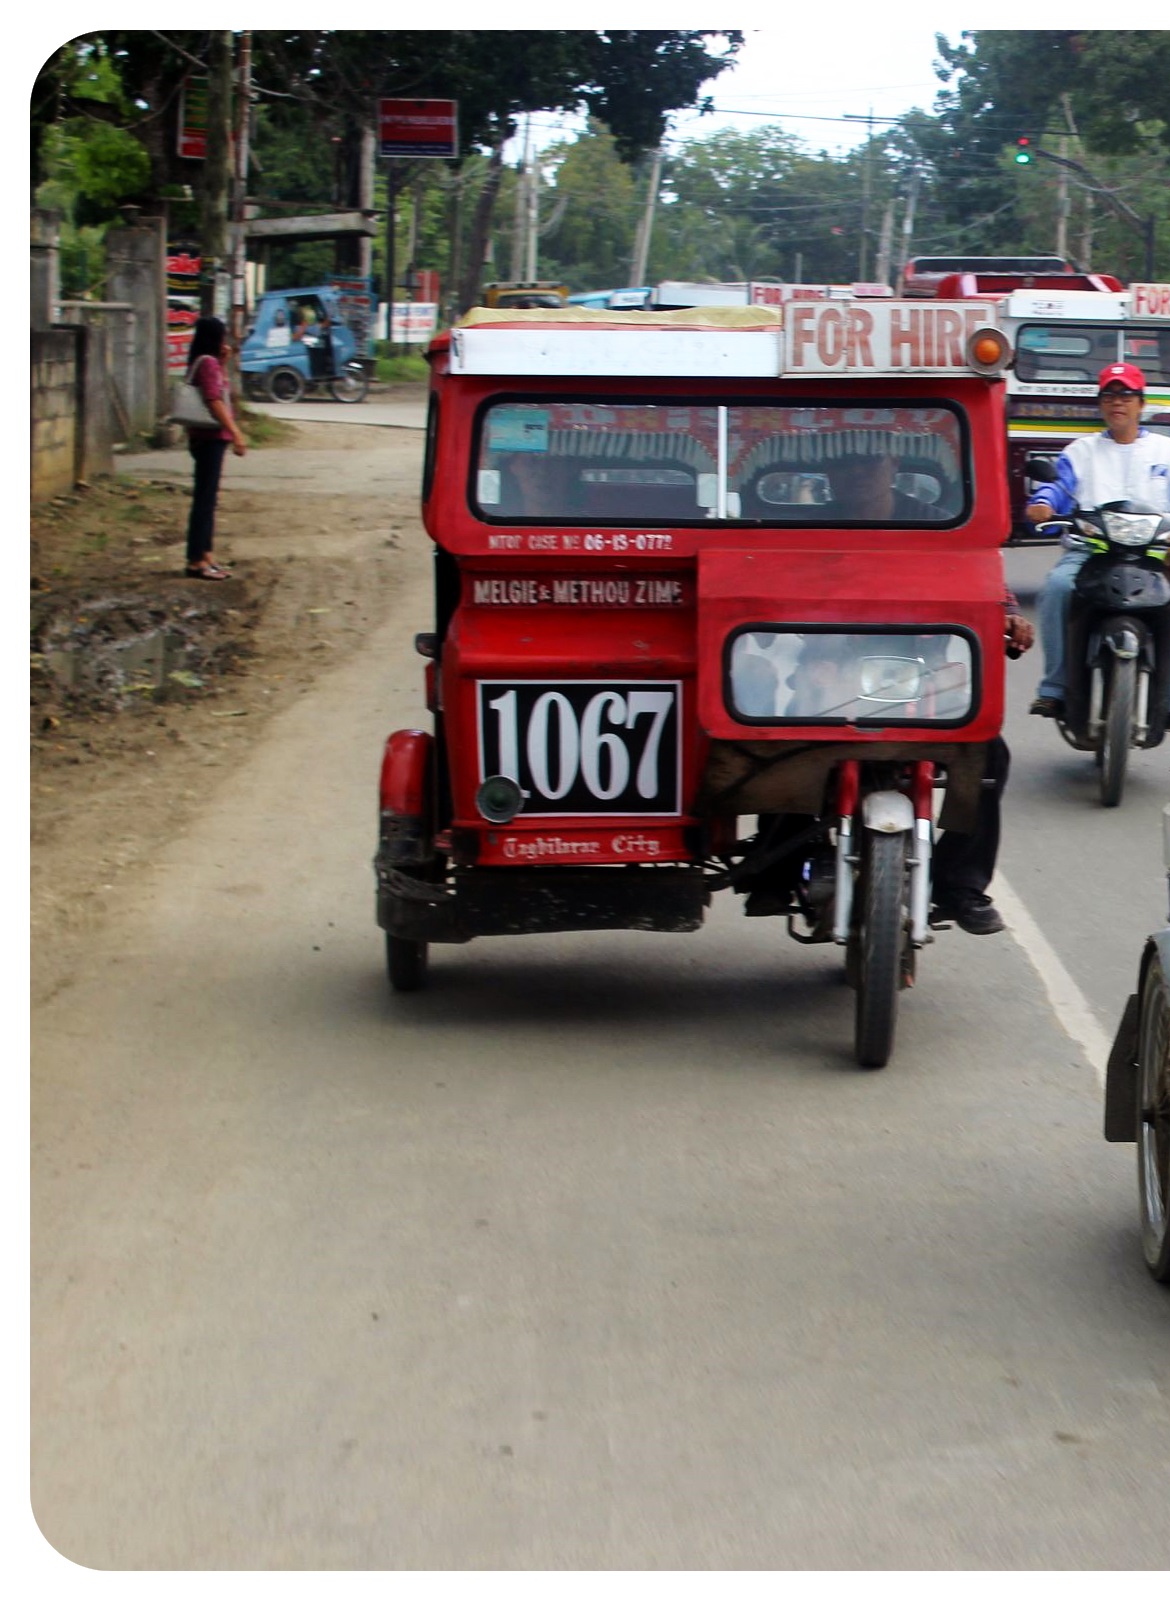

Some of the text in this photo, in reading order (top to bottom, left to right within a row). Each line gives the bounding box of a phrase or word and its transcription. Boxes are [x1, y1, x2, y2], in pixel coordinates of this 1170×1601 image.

[793, 307, 874, 367] FOR
[489, 690, 674, 800] 1067
[612, 834, 660, 856] City
